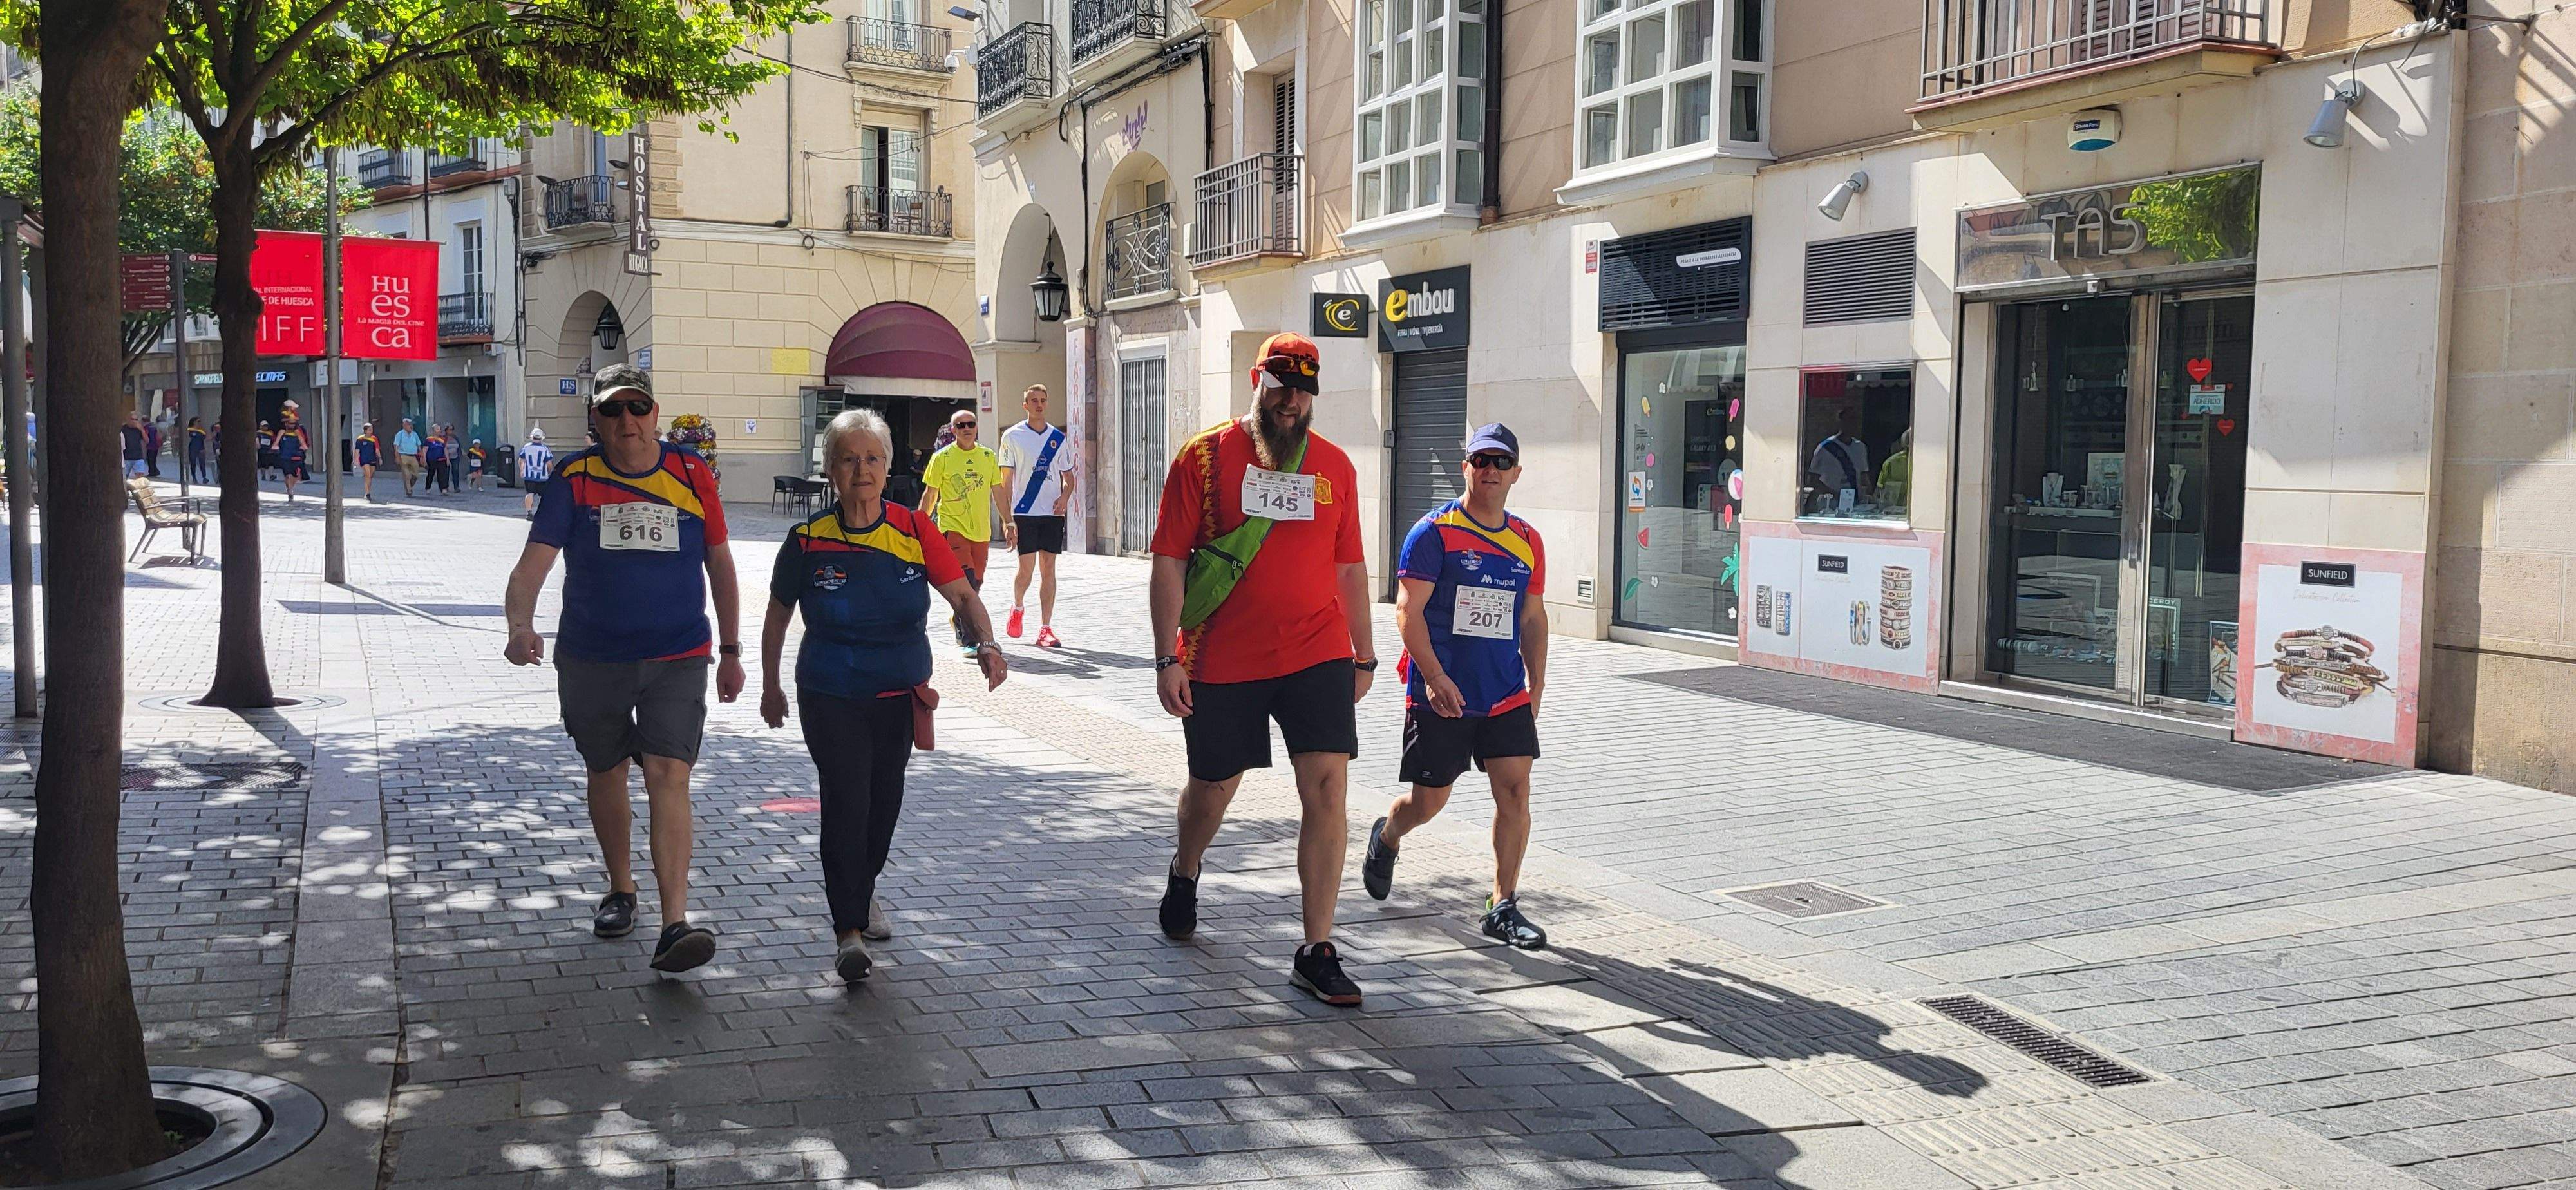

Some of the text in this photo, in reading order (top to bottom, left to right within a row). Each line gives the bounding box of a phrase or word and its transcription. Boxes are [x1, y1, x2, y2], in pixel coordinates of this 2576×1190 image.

[634, 135, 647, 250] HOSTAL
[2041, 202, 2146, 261] TAS
[629, 253, 649, 274] RUGACA
[268, 296, 280, 305] DE
[281, 297, 314, 306] HUESCA
[1385, 281, 1455, 322] embou
[262, 316, 315, 342] IFF
[1428, 323, 1443, 334] ENERGÍA
[256, 371, 287, 382] ECIMAS
[562, 379, 576, 390] HS
[1072, 338, 1080, 517] FARMACIA
[1258, 493, 1299, 513] 145
[619, 524, 663, 542] 616
[1821, 559, 1844, 569] SUNFIELD
[1494, 578, 1516, 587] mupol
[2307, 569, 2348, 580] SUNFIELD
[1469, 611, 1502, 628] 207
